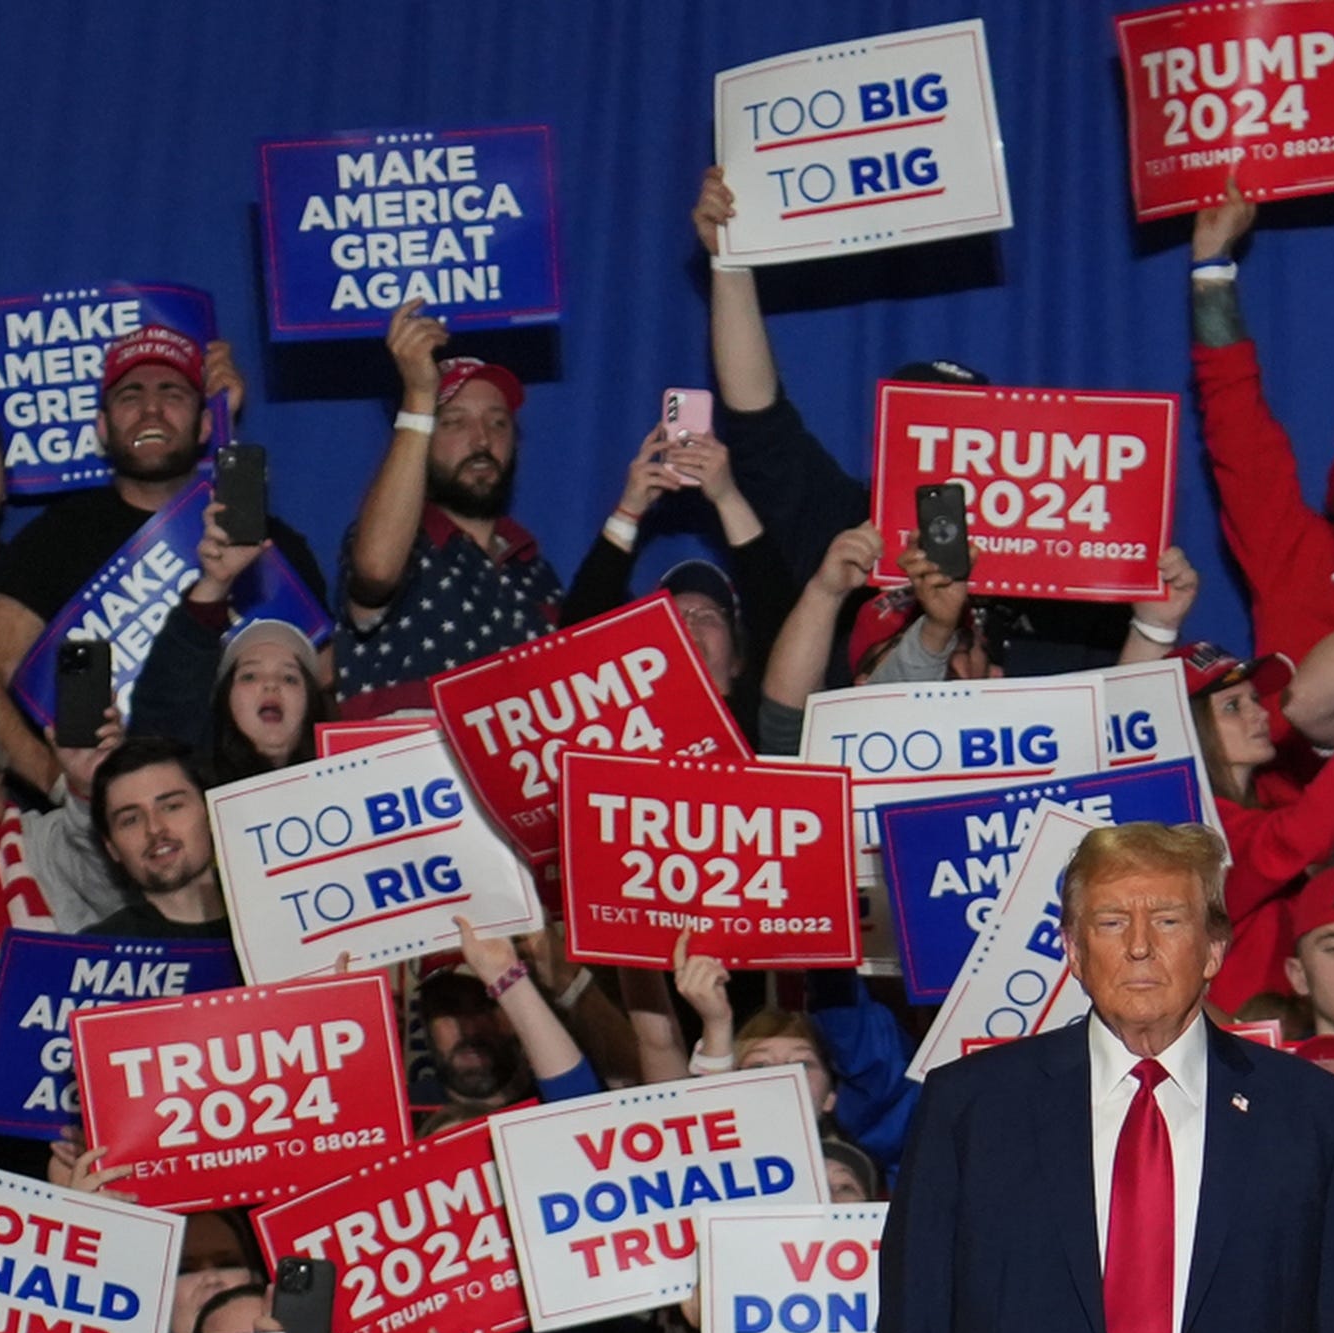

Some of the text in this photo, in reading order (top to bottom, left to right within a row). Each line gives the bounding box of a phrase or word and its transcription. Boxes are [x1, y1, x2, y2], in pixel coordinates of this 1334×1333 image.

[743, 73, 949, 141] TOO BIG
[1162, 82, 1310, 147] 2024
[337, 146, 476, 190] MAKE
[769, 147, 939, 210] TO RIG
[1145, 157, 1177, 177] TEXT
[1180, 145, 1246, 169] TRUMP
[1251, 141, 1278, 160] TO
[299, 183, 522, 231] AMERICA
[330, 226, 494, 271] GREAT
[330, 266, 503, 311] AGAIN!
[6, 300, 142, 347] MAKE
[906, 425, 1146, 481] TRUMP
[1044, 540, 1147, 559] TO 88022
[67, 540, 185, 643] MAKE
[463, 645, 668, 758] TRUMP
[831, 725, 1059, 773] TOO BIG
[246, 777, 465, 866] TOO BIG
[588, 793, 822, 858] TRUMP
[282, 854, 463, 931] TO RIG
[620, 850, 789, 908] 2024
[589, 903, 834, 935] TEXT TRUMP TO 88022
[69, 959, 190, 999] MAKE
[109, 1019, 365, 1099] TRUMP
[154, 1076, 340, 1148] 2024
[574, 1109, 742, 1172] VOTE
[187, 1126, 387, 1171] TRUMP TO 88022
[539, 1156, 796, 1235] DONALD
[340, 1215, 513, 1320] 2024
[570, 1218, 698, 1278] TRU
[454, 1281, 484, 1303] TO
